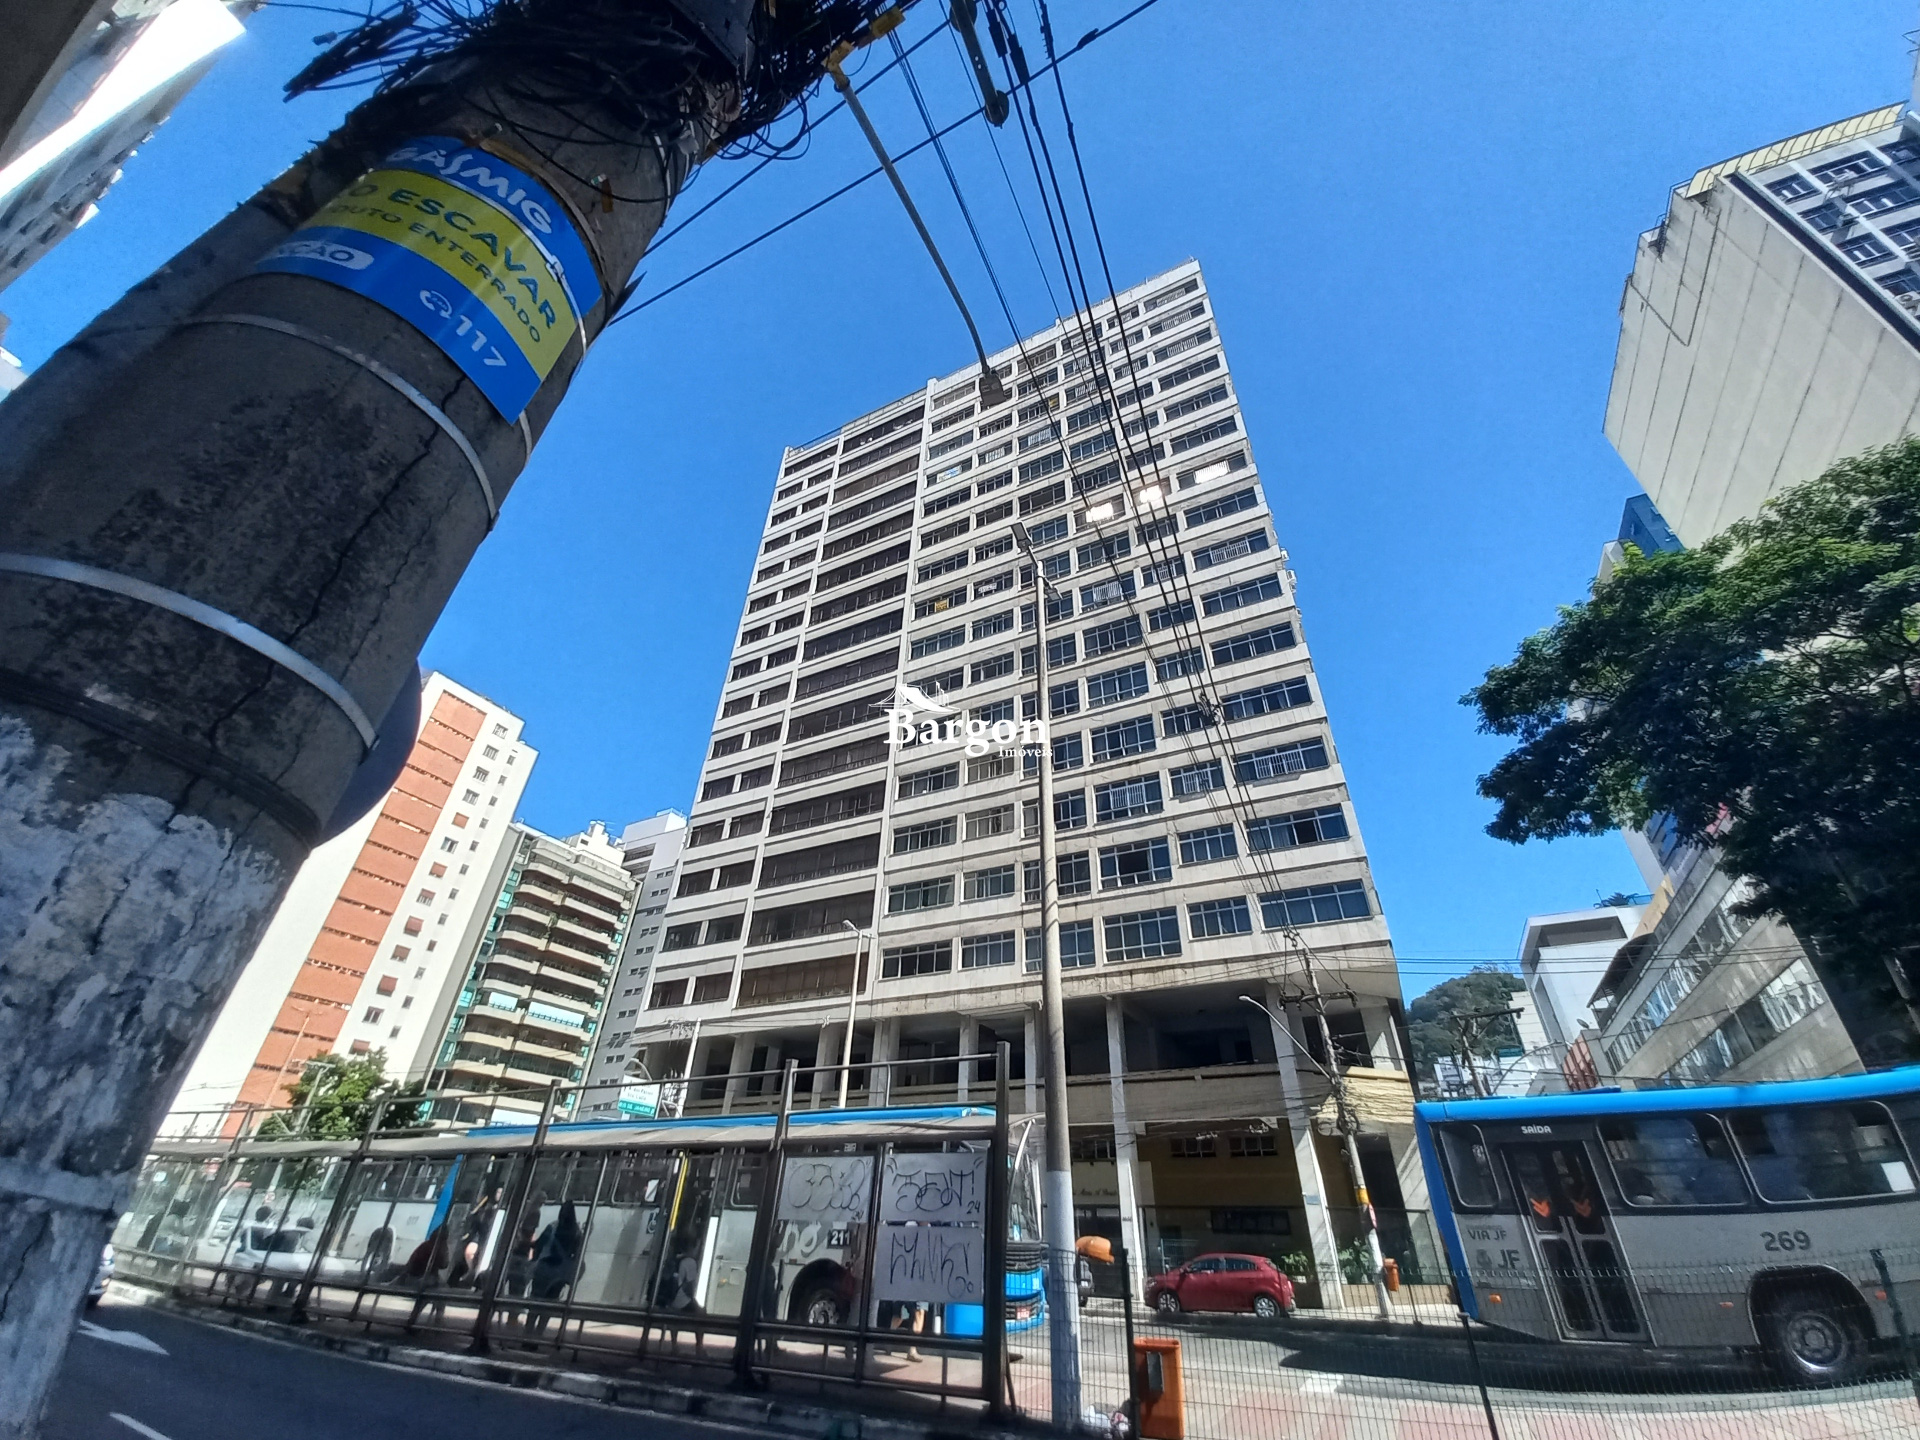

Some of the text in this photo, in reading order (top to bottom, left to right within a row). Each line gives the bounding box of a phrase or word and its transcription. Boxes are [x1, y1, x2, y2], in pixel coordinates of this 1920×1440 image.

[387, 188, 557, 331] ESCAVAR
[408, 222, 541, 344] ENTERRADO
[455, 316, 508, 368] 117
[1520, 1124, 1552, 1134] SAÍDA
[1468, 1229, 1507, 1241] VIA JF
[1760, 1230, 1810, 1251] 269
[1498, 1249, 1520, 1269] JF
